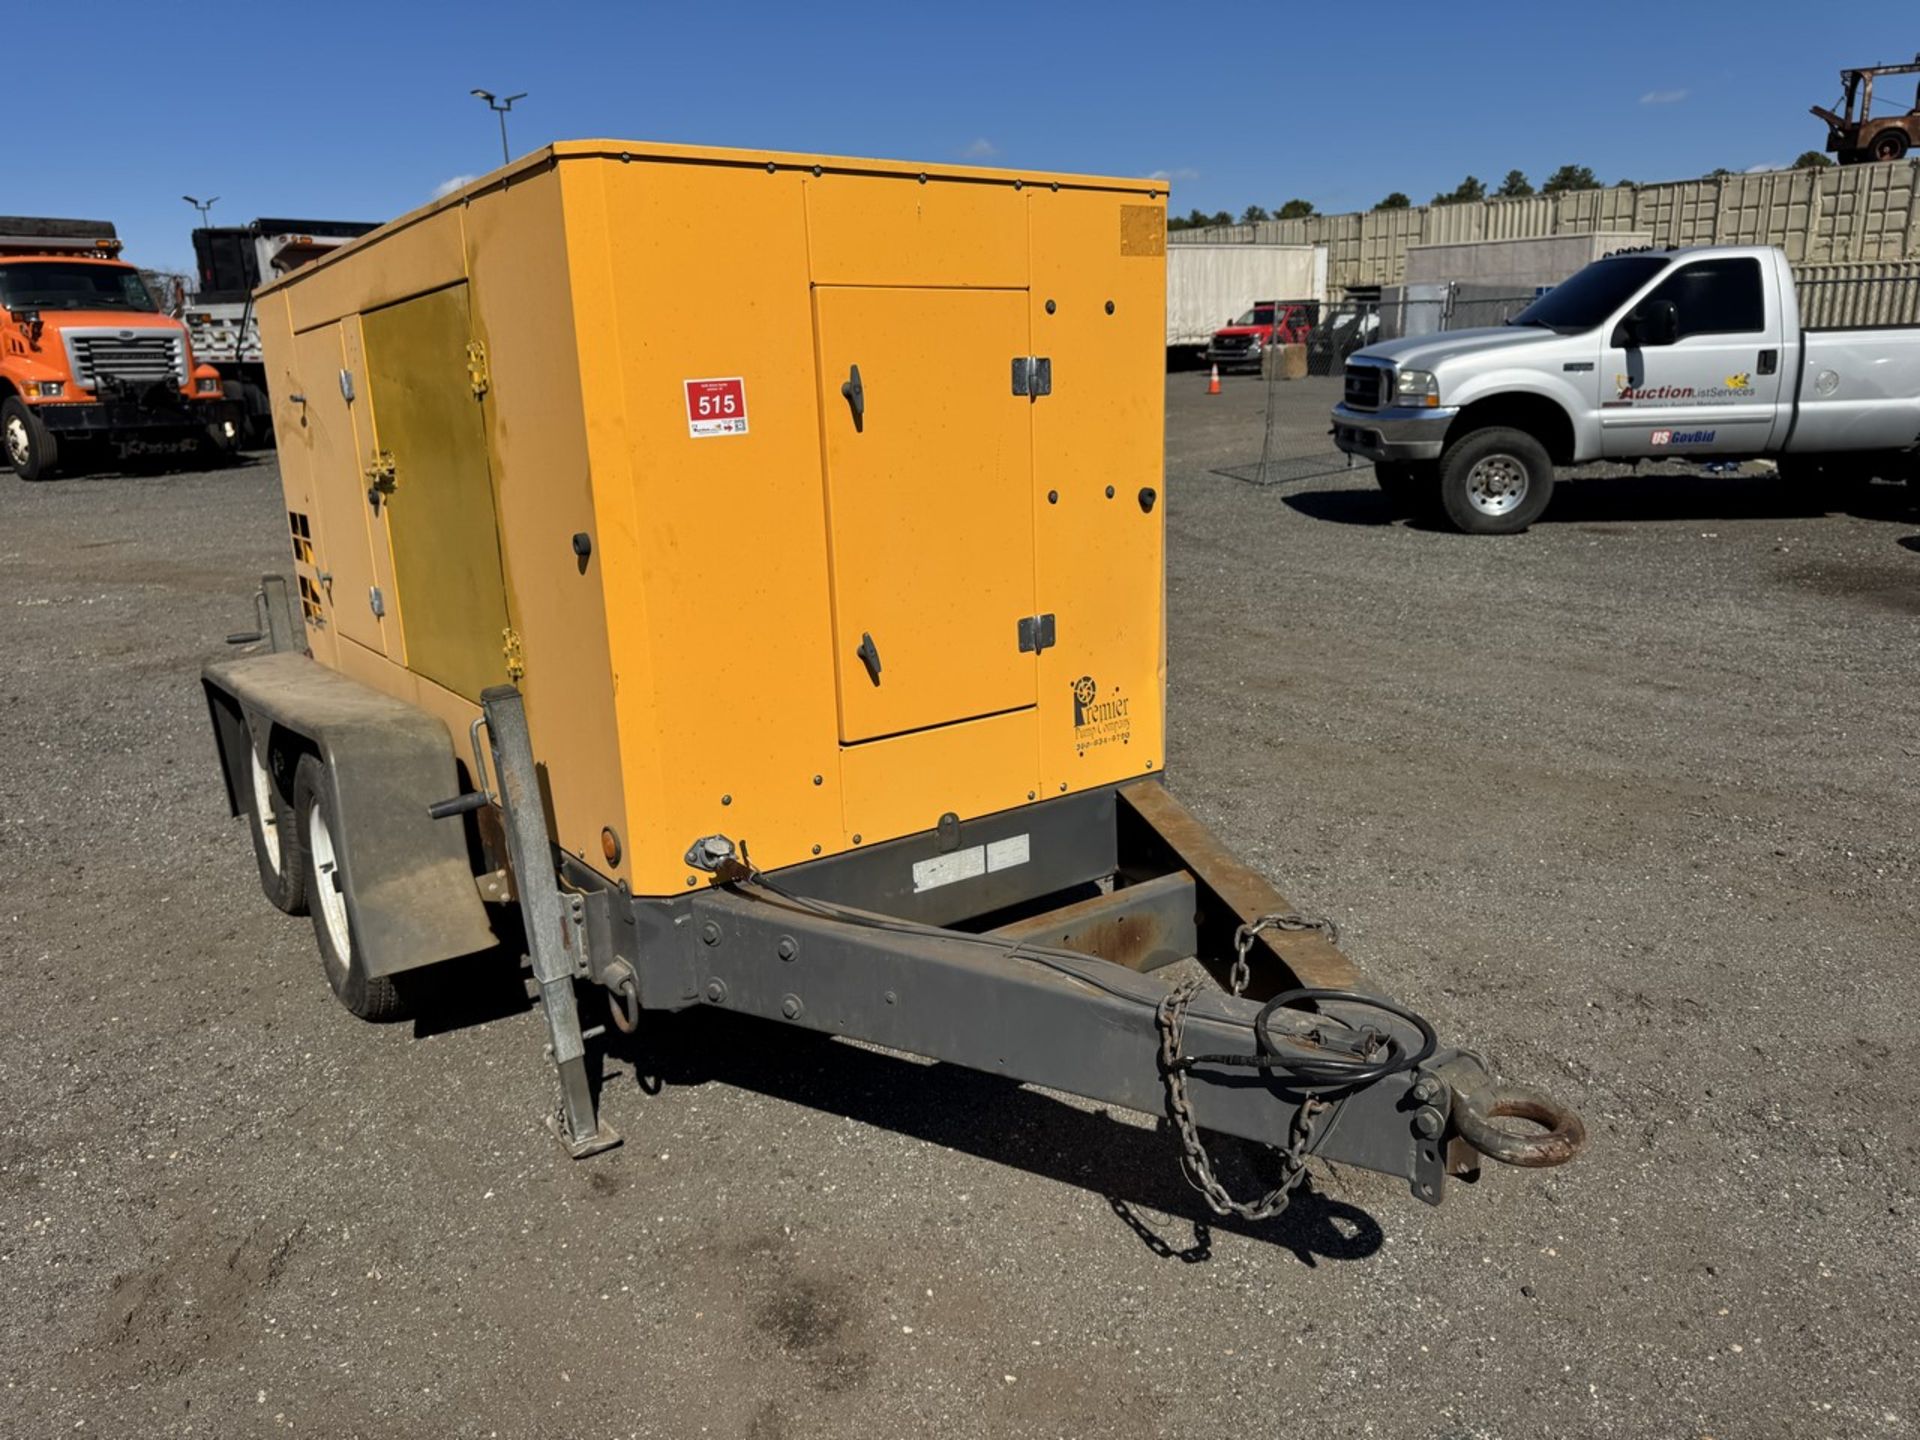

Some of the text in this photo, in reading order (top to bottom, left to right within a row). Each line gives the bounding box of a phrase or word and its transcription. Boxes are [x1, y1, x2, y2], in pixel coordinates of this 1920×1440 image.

[698, 394, 736, 416] 515
[1651, 430, 1671, 445] US
[1074, 675, 1129, 727] Premier
